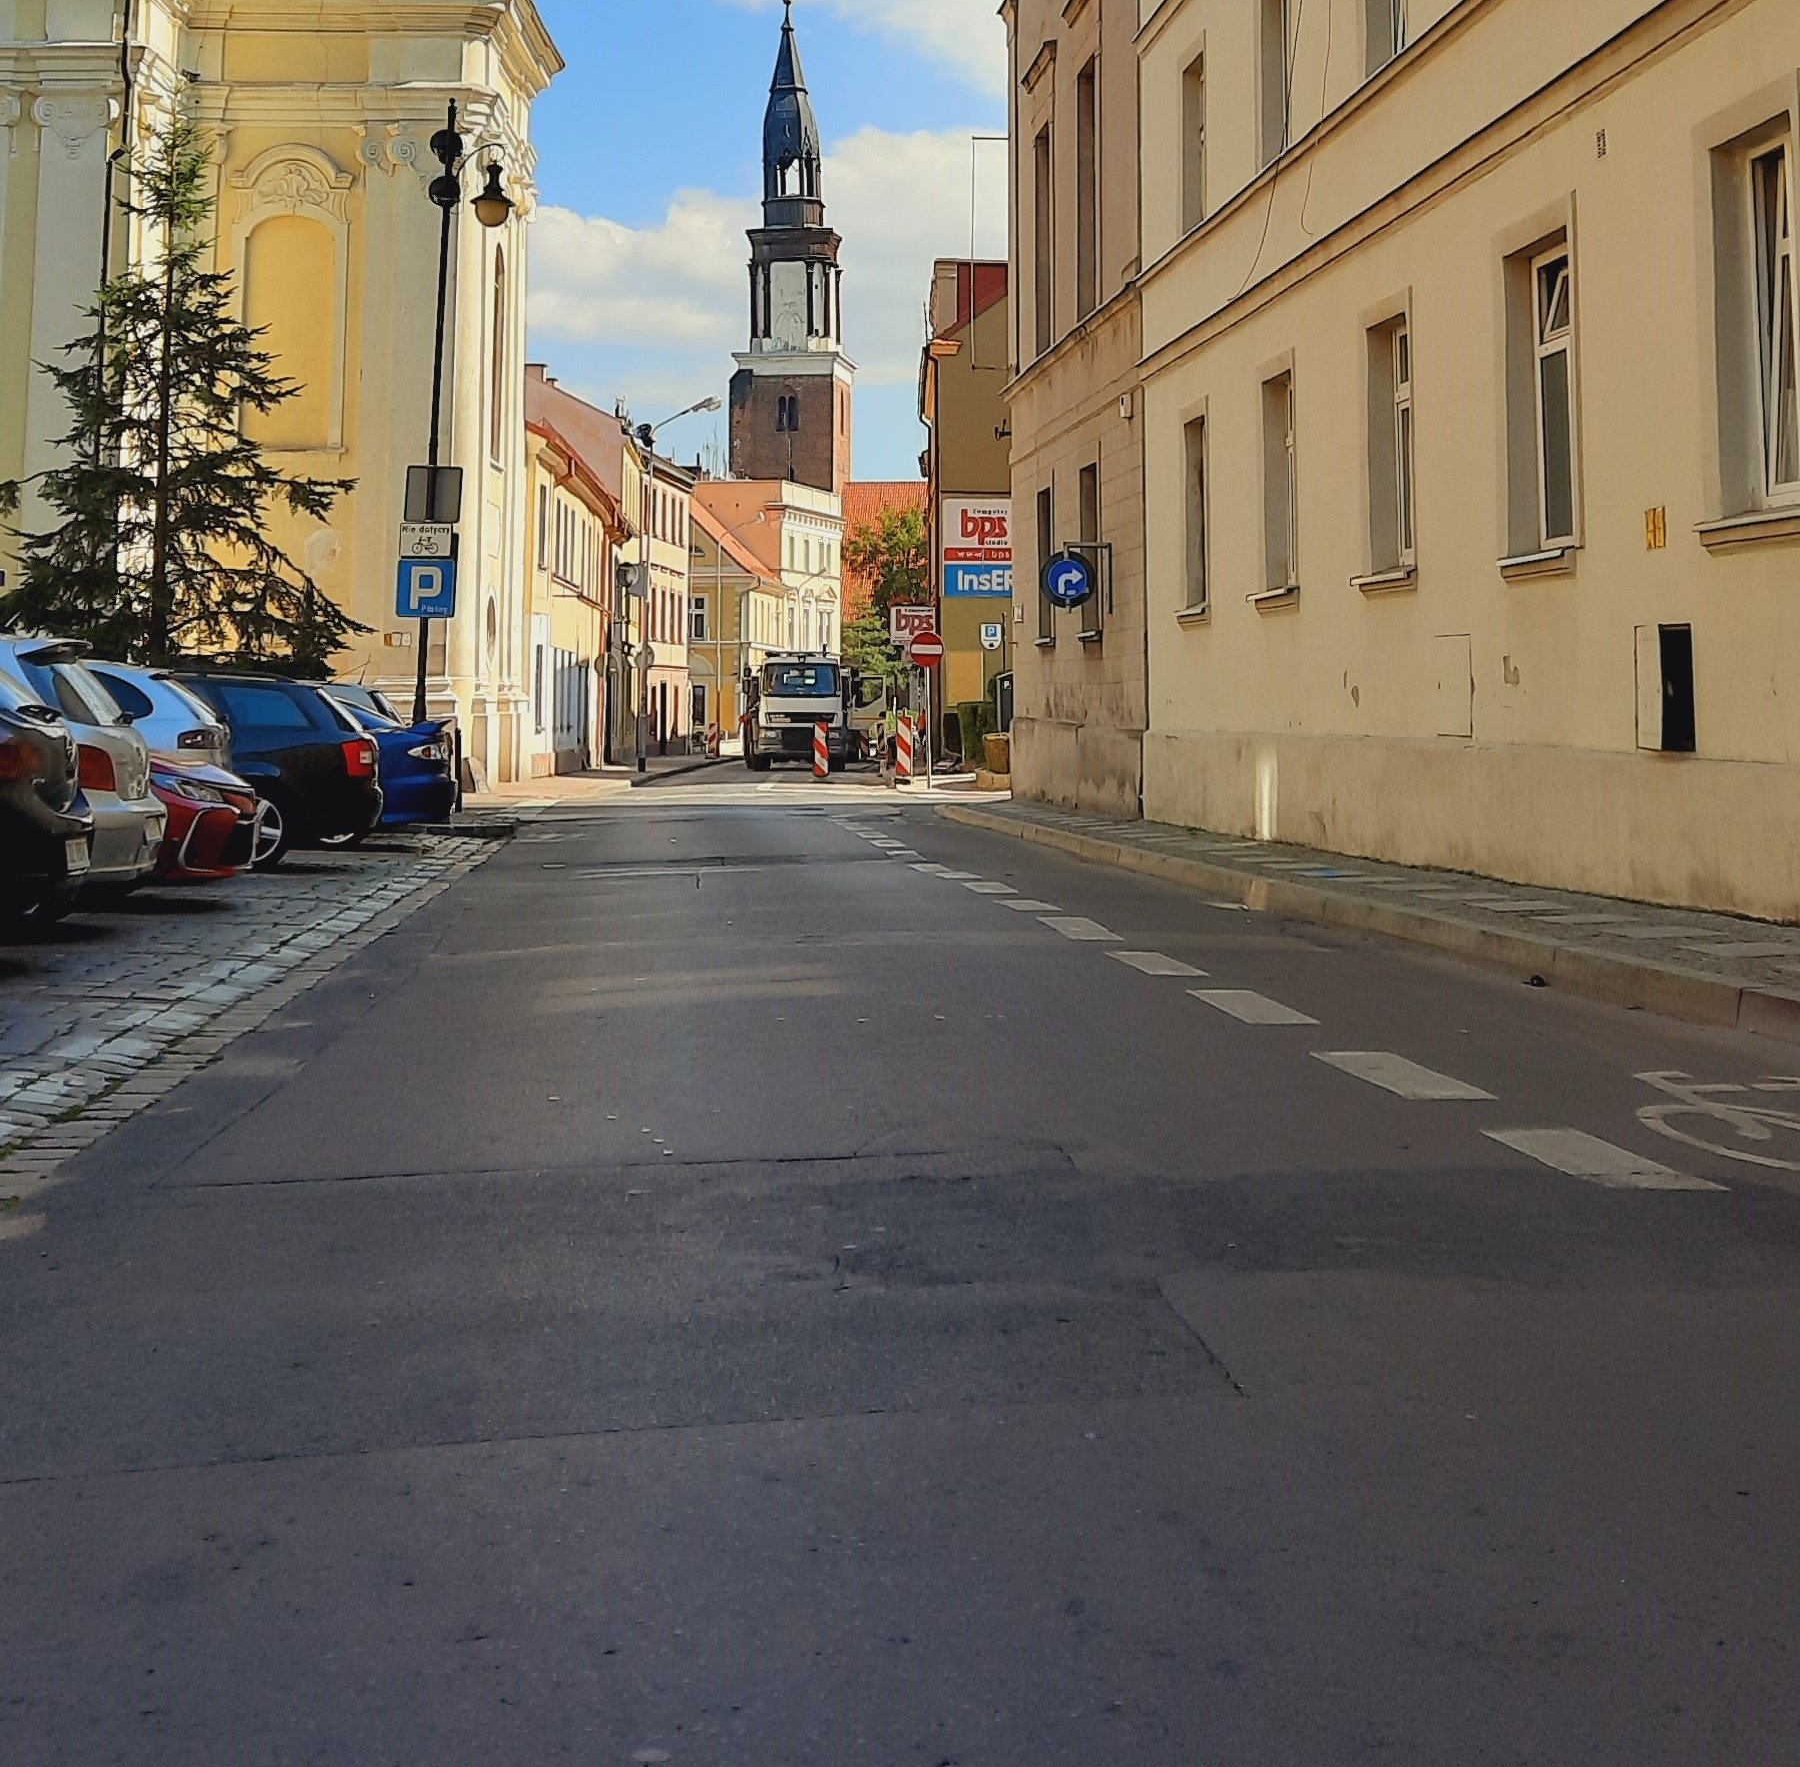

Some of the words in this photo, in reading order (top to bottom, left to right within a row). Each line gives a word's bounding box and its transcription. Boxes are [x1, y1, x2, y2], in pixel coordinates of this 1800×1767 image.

[961, 508, 1007, 545] bps
[409, 566, 442, 610] P
[895, 608, 934, 637] bps
